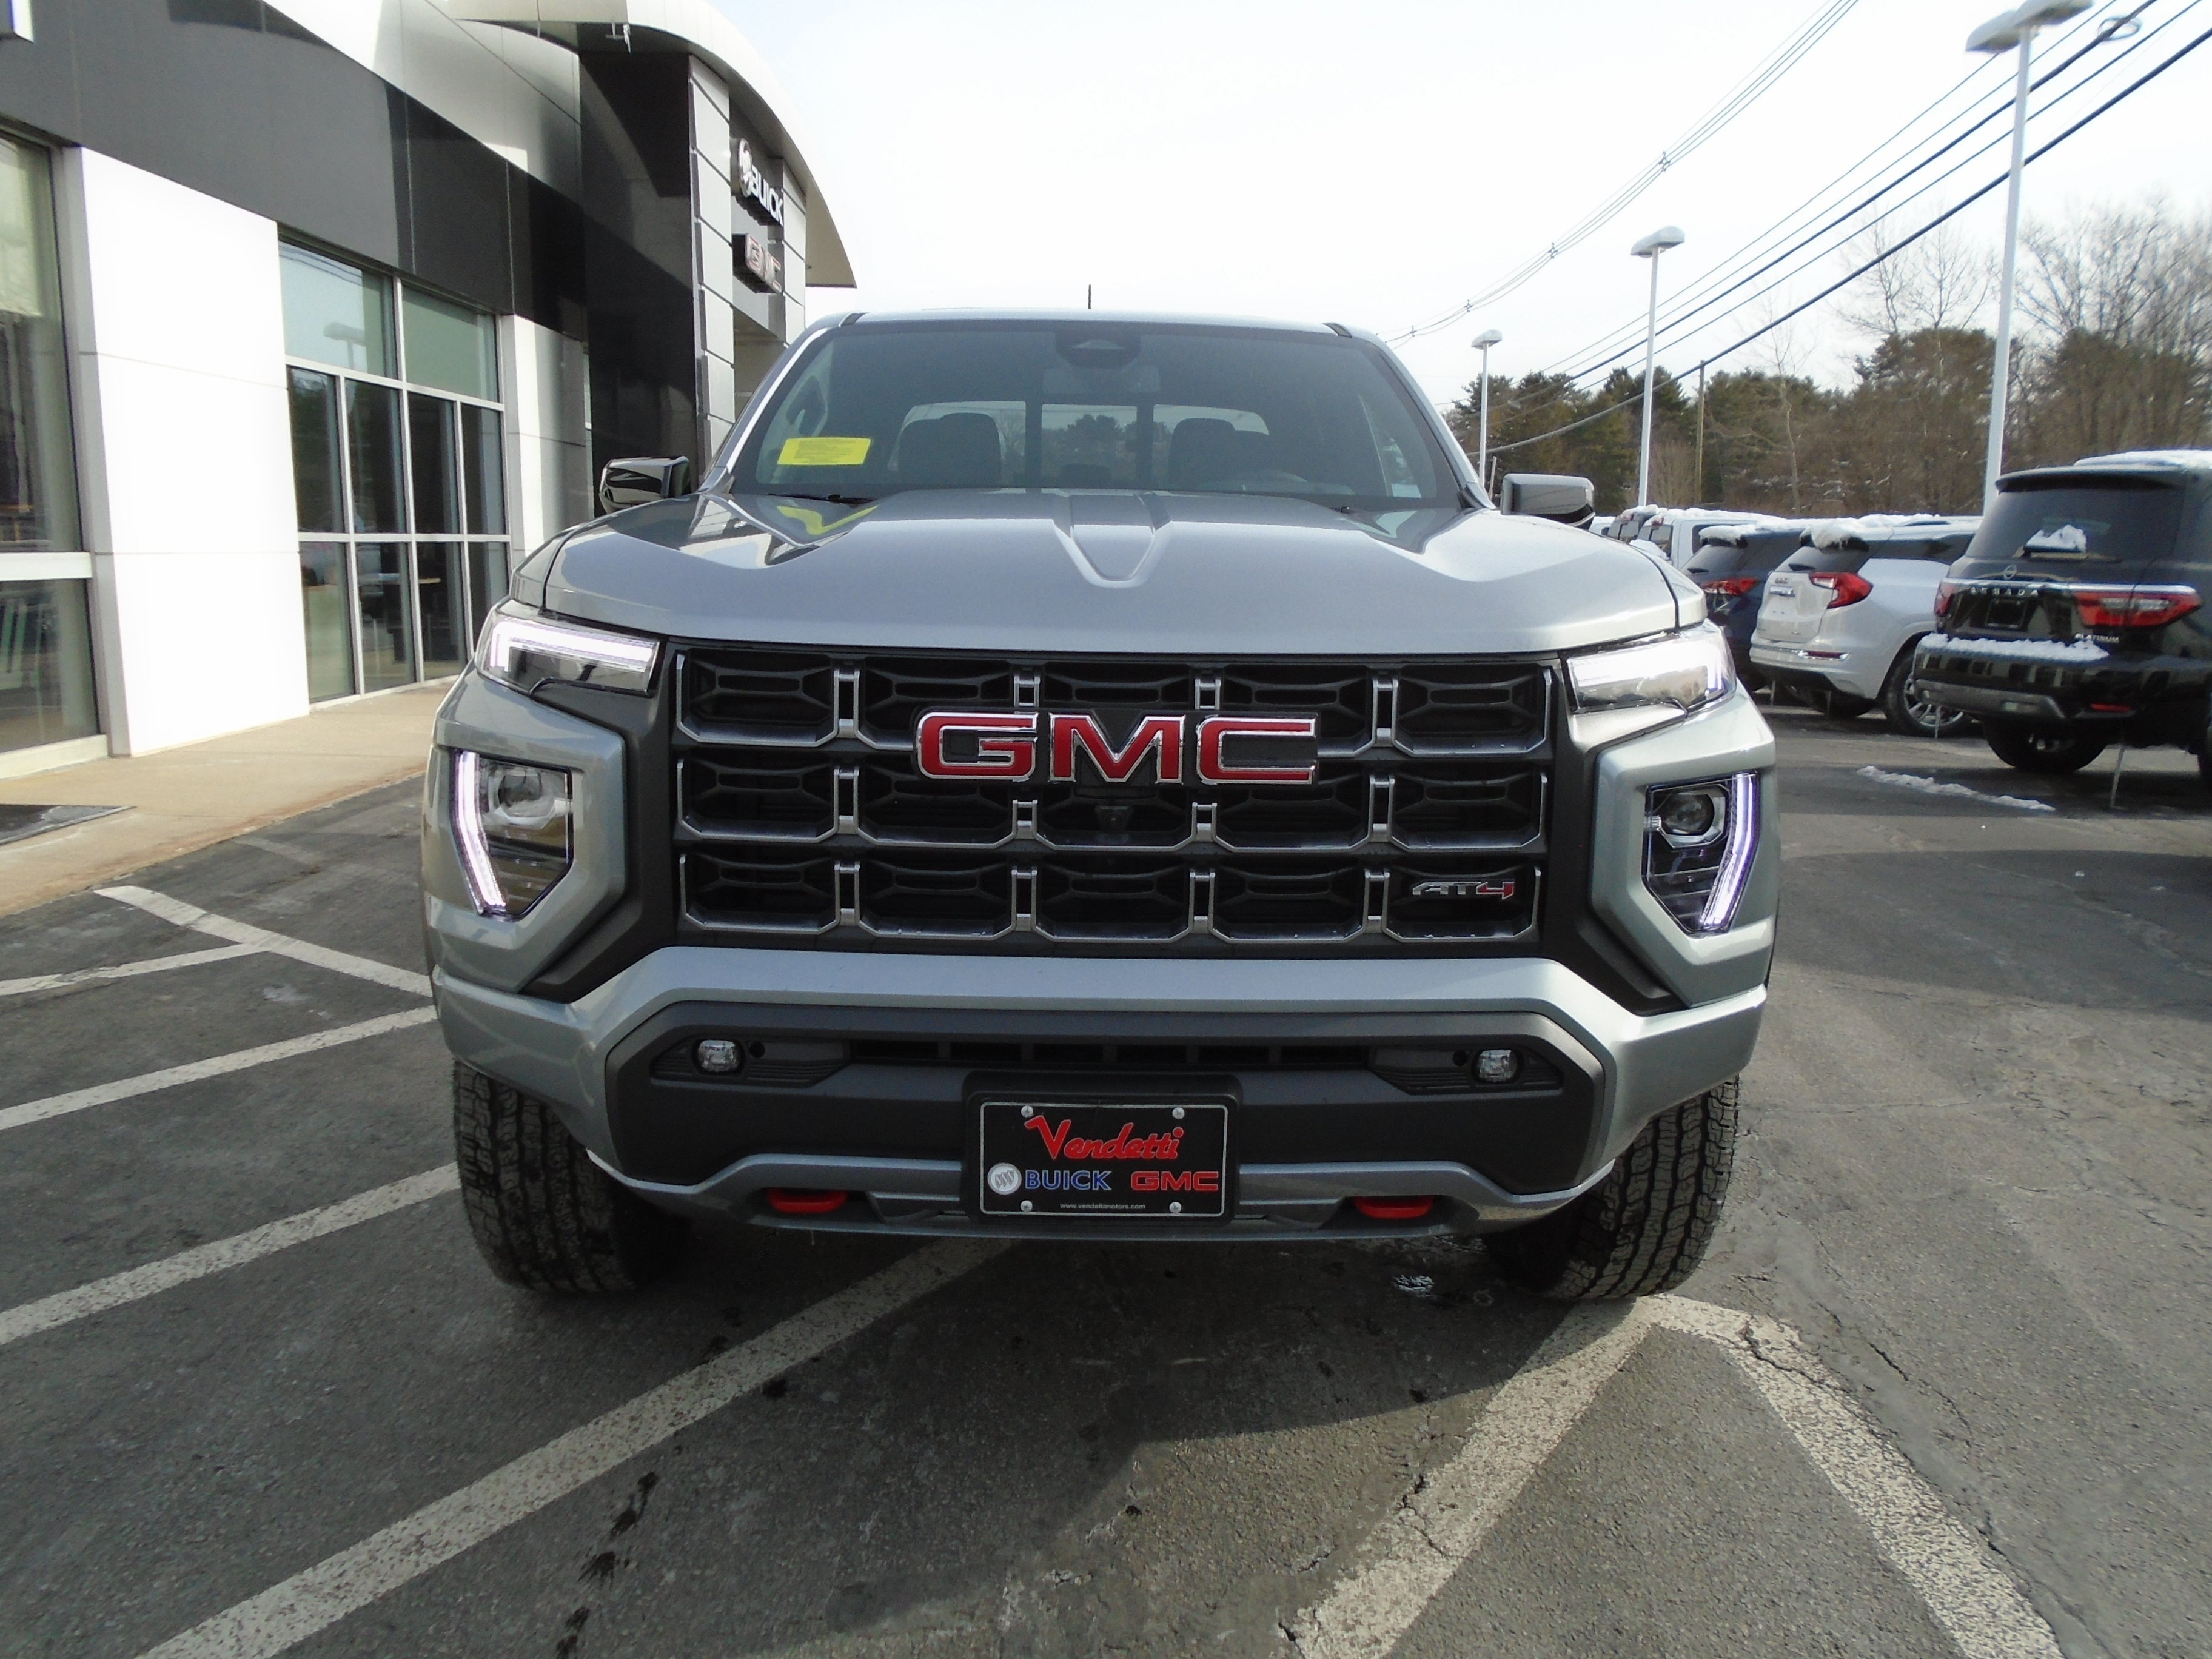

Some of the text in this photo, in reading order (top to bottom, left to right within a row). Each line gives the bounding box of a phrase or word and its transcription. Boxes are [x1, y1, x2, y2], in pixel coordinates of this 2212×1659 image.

[751, 165, 784, 227] BUICK
[2075, 632, 2120, 643] PLATINUM
[917, 712, 1317, 785] GMC
[1412, 881, 1515, 900] AT4
[1024, 1114, 1184, 1160] Vendetti
[1025, 1170, 1219, 1191] BUICK GMC
